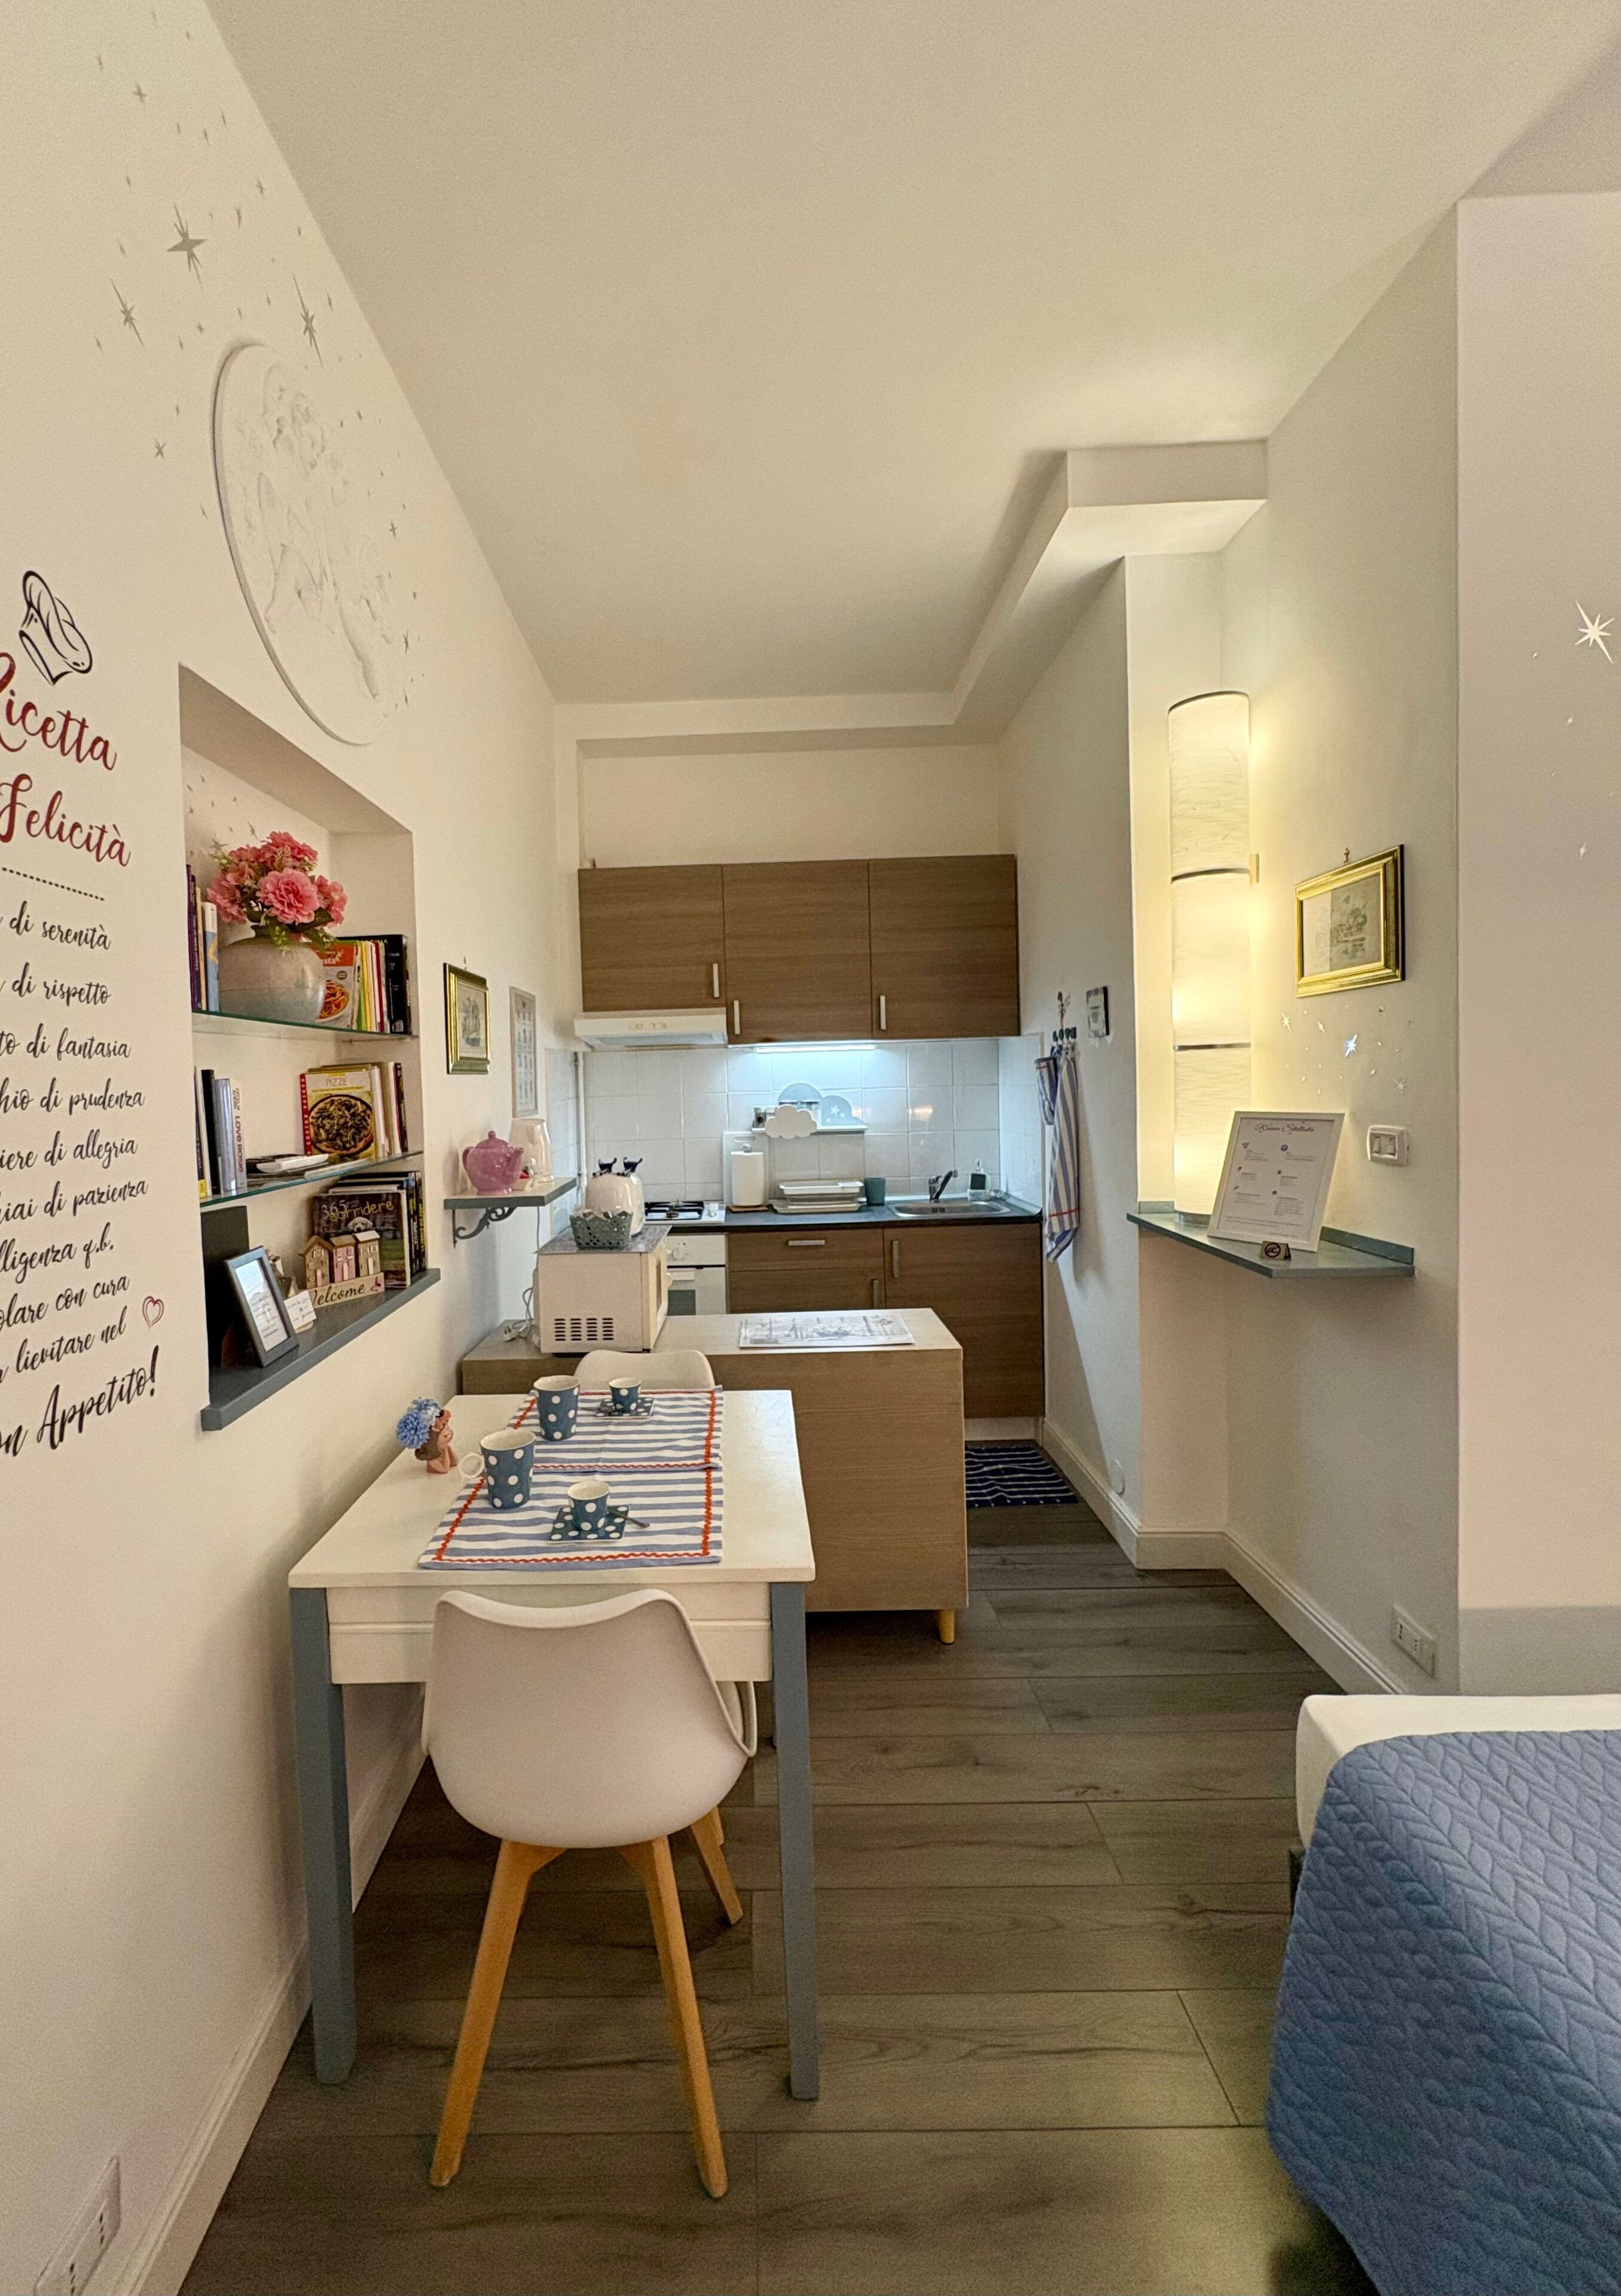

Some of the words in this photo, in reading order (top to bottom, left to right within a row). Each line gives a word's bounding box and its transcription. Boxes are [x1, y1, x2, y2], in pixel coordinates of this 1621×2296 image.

[0, 774, 131, 866] Felicità
[10, 900, 34, 935] di
[42, 921, 111, 949] serenità
[12, 962, 36, 997] di
[43, 980, 111, 1007] rispetto
[27, 1023, 50, 1058] di
[57, 1027, 131, 1061] fantasia
[40, 1077, 63, 1112] di
[69, 1078, 145, 1116] prudenza
[325, 1077, 348, 1087] PIZZE
[44, 1131, 67, 1166] di
[73, 1129, 138, 1169] allegria
[0, 1190, 38, 1225] iai
[44, 1180, 67, 1217] di
[72, 1180, 149, 1217] pazienza
[321, 1199, 347, 1220] 365
[328, 1201, 395, 1222] sorridere
[83, 1222, 114, 1269] q.b.
[55, 1289, 87, 1311] con
[93, 1276, 130, 1299] cura
[313, 1284, 366, 1306] elcome
[16, 1338, 95, 1373] lievitare
[101, 1305, 127, 1344] nel
[0, 1425, 28, 1457] n
[36, 1345, 159, 1450] Appetito!
